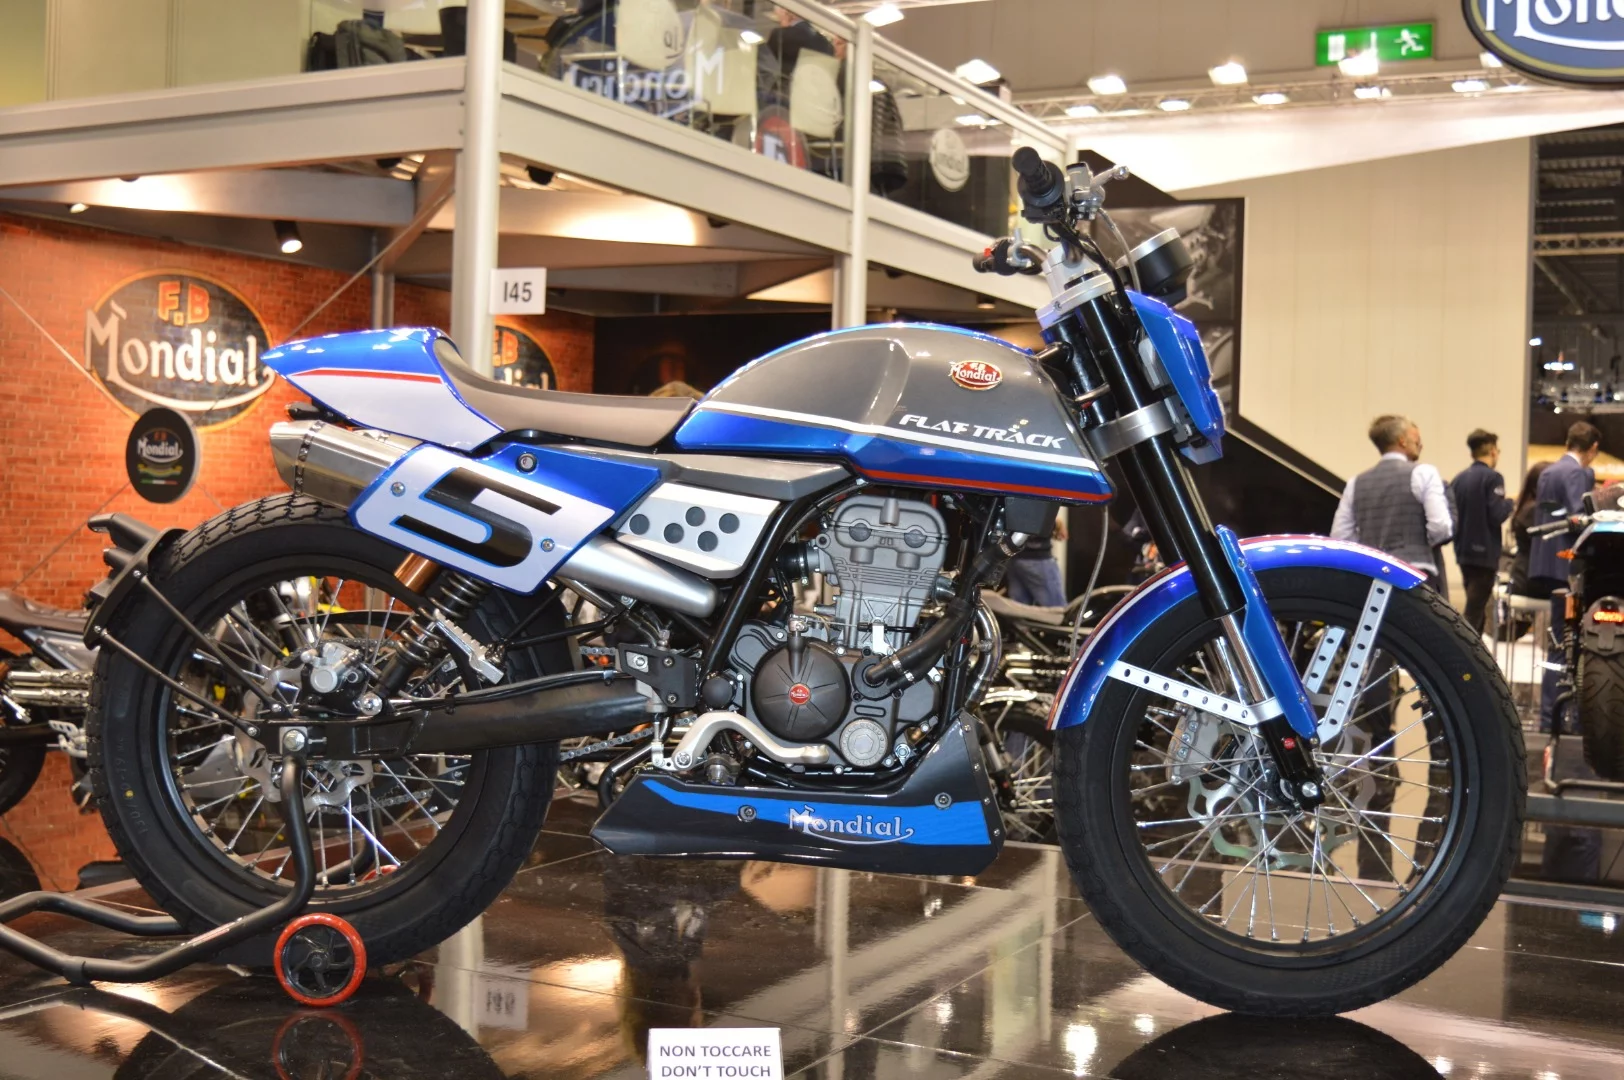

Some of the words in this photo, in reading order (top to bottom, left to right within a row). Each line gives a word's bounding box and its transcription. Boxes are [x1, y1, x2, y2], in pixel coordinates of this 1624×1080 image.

[85, 300, 275, 411] Mondial
[948, 361, 1001, 386] Mondial
[898, 414, 970, 435] FLAT
[973, 424, 1067, 449] TRACK
[137, 436, 184, 463] Mondial
[788, 804, 914, 845] Mondial
[660, 1045, 696, 1057] NON
[700, 1045, 772, 1057] TOCCARE
[661, 1065, 712, 1078] DON'T
[716, 1065, 771, 1078] TOUCH
